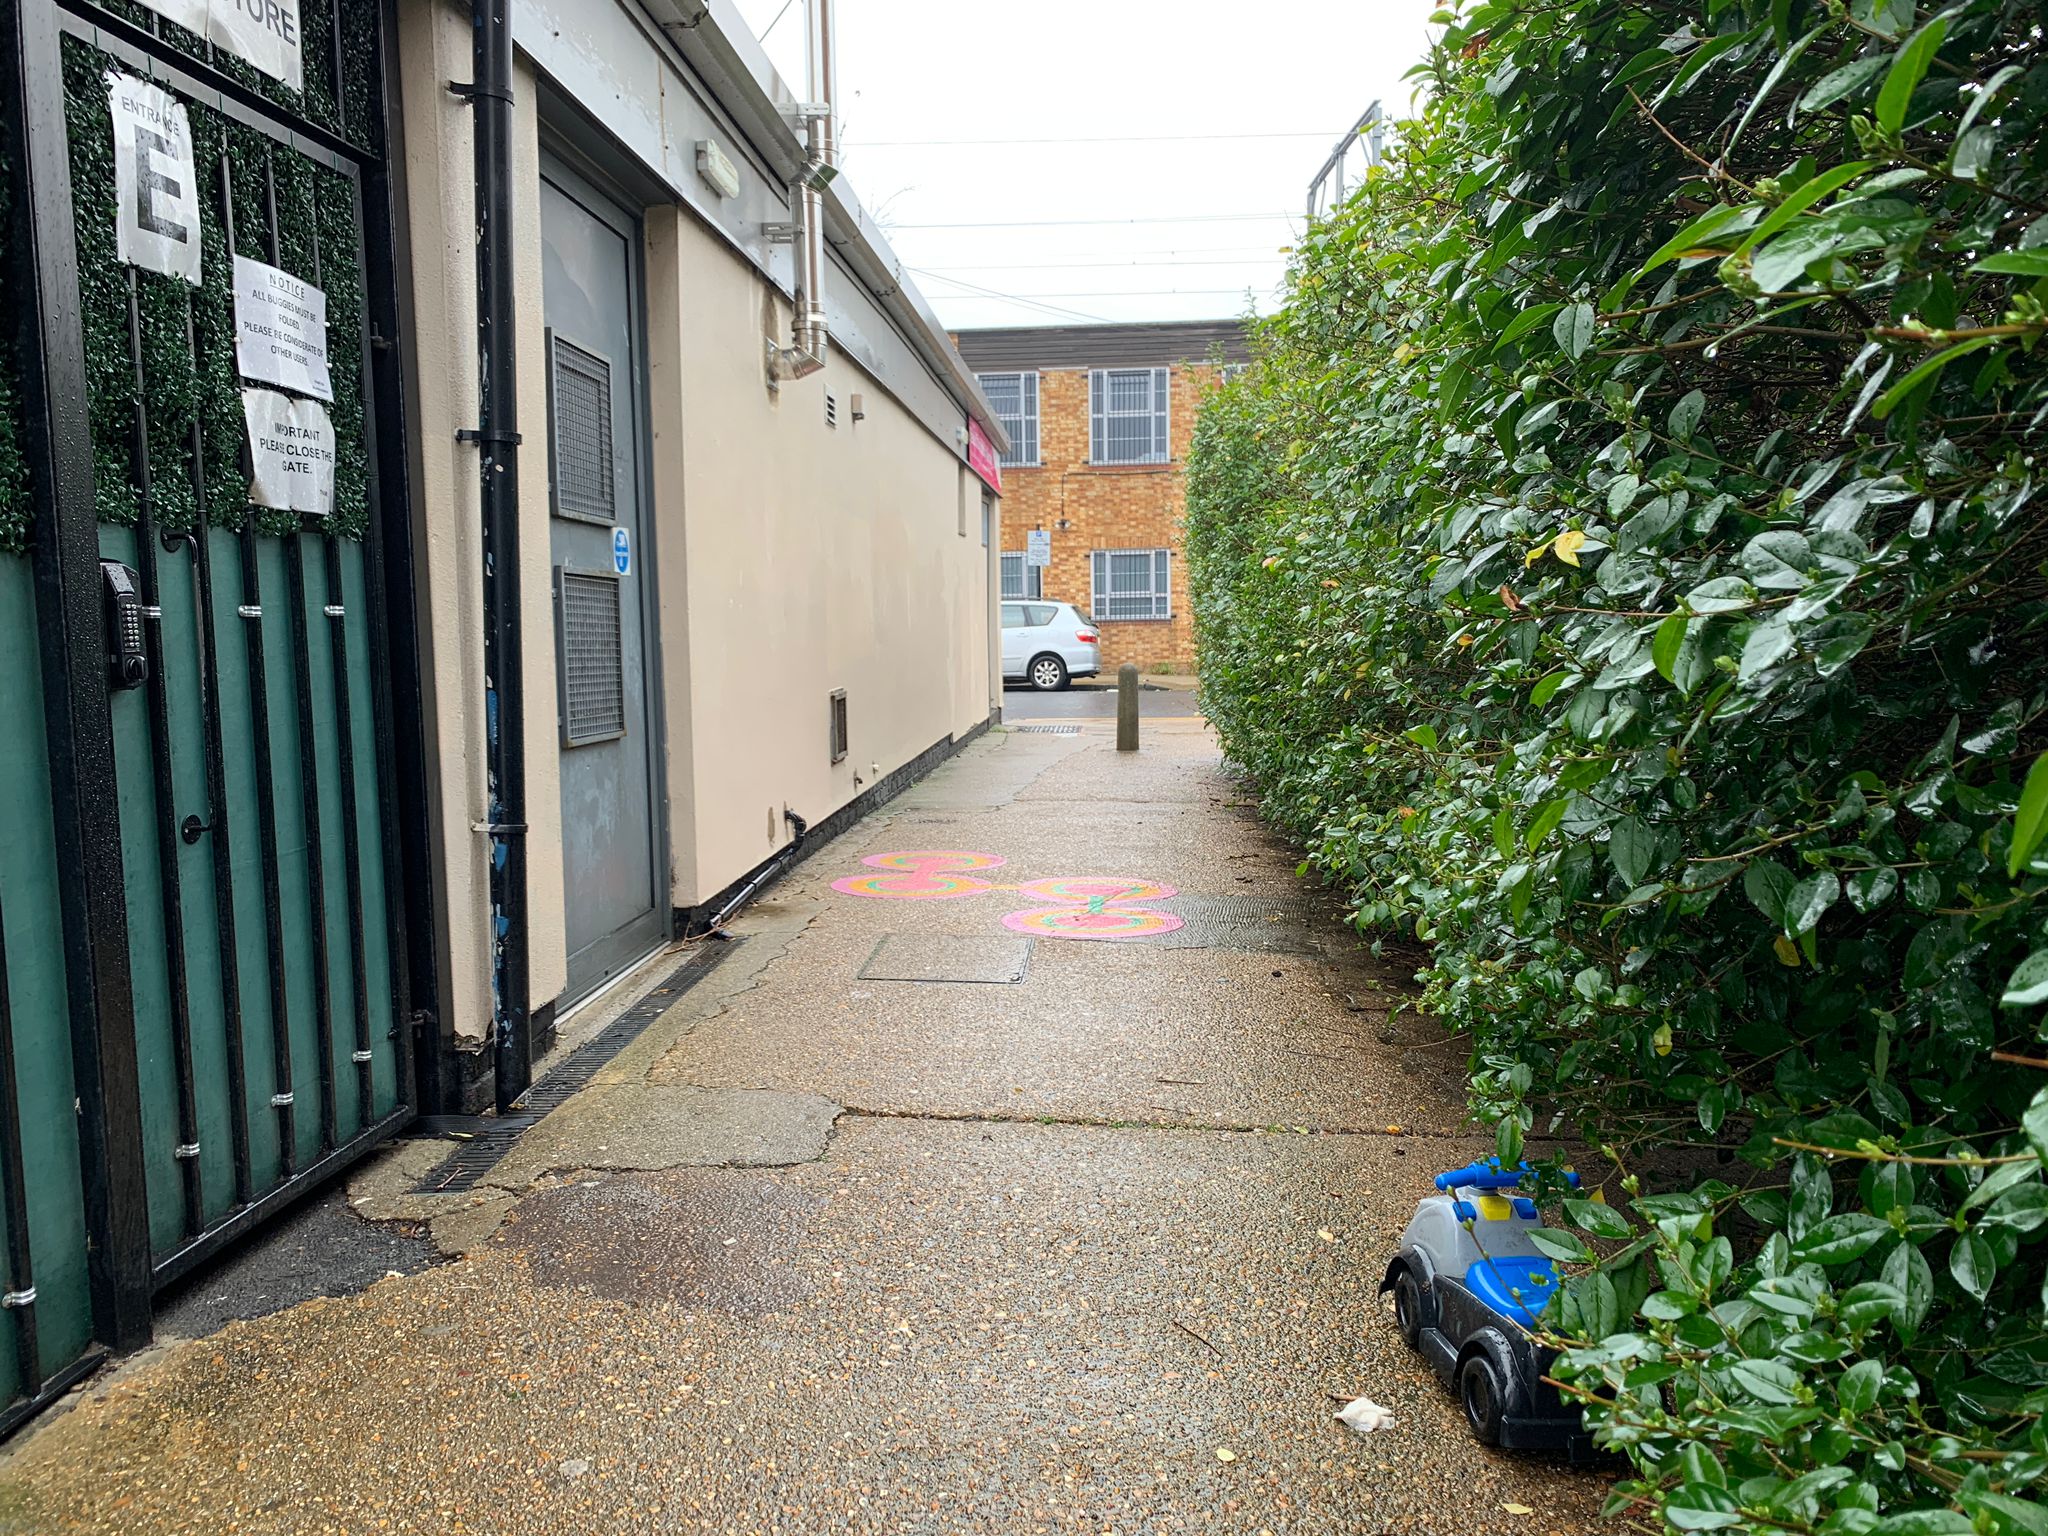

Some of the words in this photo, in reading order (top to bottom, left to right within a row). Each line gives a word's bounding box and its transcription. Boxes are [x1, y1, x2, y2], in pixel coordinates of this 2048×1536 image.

[224, 0, 297, 47] ORE
[121, 96, 180, 136] ENTRANCE
[134, 124, 187, 244] E
[269, 273, 305, 299] NOTICE
[252, 289, 266, 302] ALL
[267, 294, 295, 313] BUGGIES
[294, 305, 309, 320] MUST
[309, 312, 316, 323] BE
[244, 321, 272, 337] PLEASE
[274, 329, 282, 341] BE
[283, 333, 317, 355] CONSIDERATE
[316, 347, 323, 358] OF
[270, 345, 292, 359] OTHER
[282, 460, 313, 475] GATE.
[286, 444, 320, 459] CLOSE
[320, 449, 333, 462] THE
